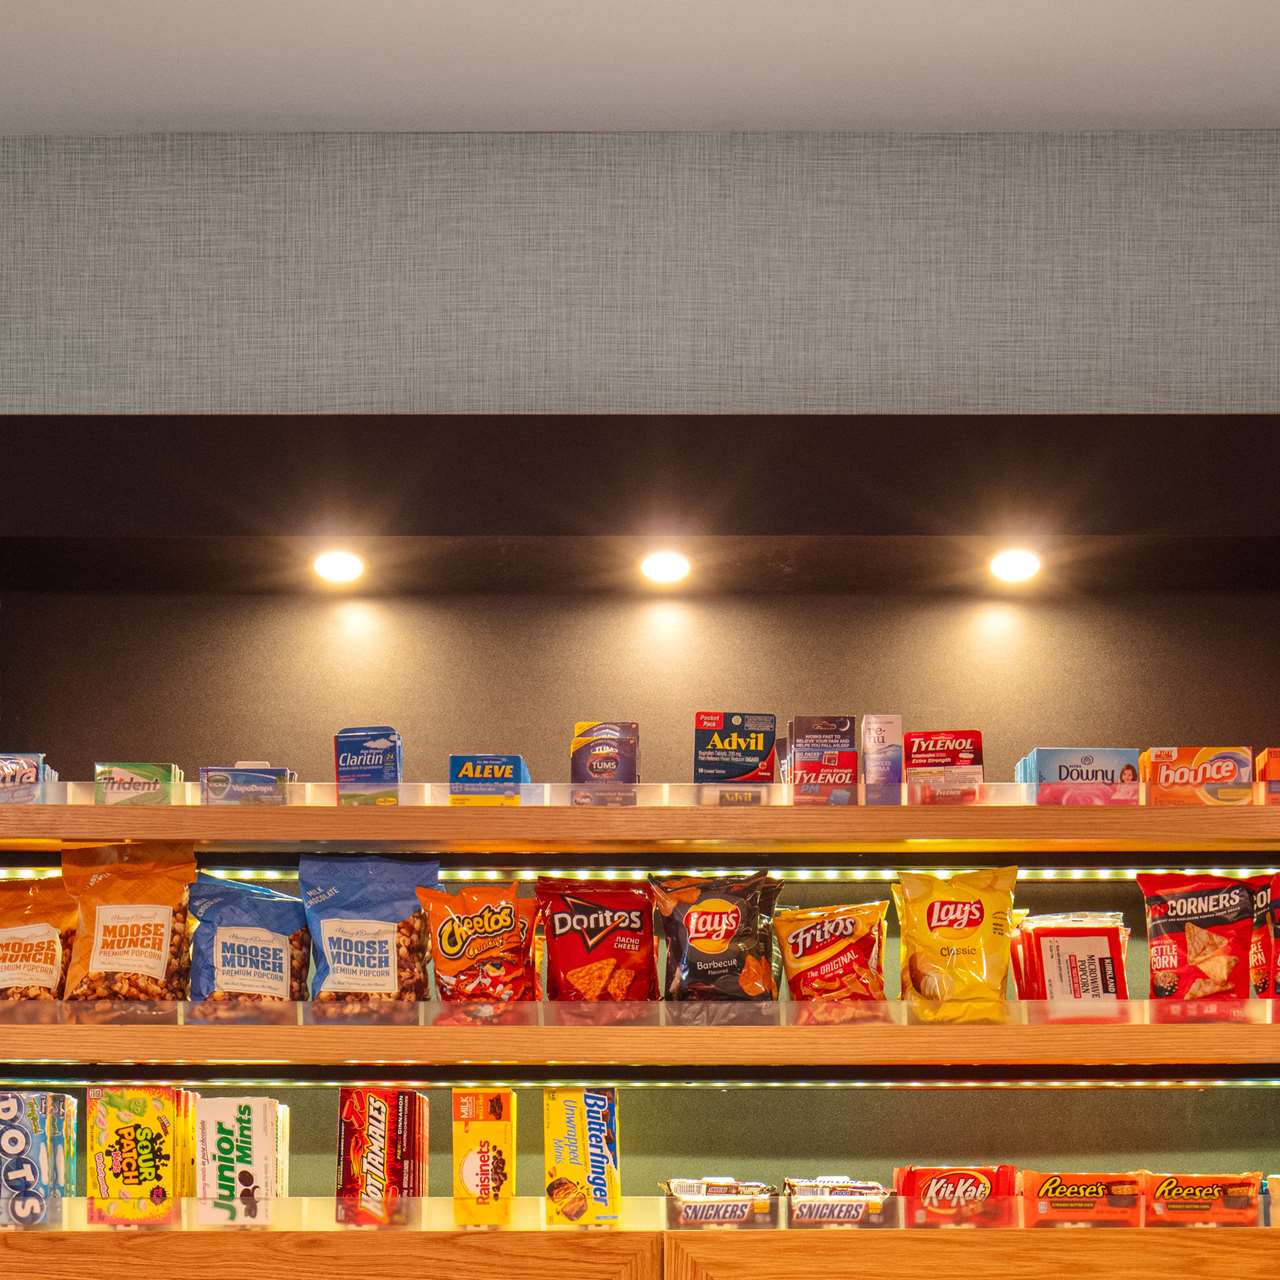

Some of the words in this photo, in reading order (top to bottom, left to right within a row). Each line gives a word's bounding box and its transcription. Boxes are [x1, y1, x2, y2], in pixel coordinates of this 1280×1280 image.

[706, 732, 764, 751] Advil
[910, 737, 974, 753] TYLENOL
[338, 752, 384, 767] Claritin
[457, 761, 514, 779] ALEVE
[591, 761, 618, 770] TUMS
[794, 770, 853, 784] TYLENOL
[1058, 764, 1116, 786] Downy
[1158, 758, 1236, 788] bounce
[104, 776, 160, 792] Trident
[724, 792, 752, 801] Advil
[553, 910, 642, 936] Doritos
[688, 906, 738, 940] Lay's
[930, 901, 982, 929] Lay's
[102, 923, 165, 938] MOOSE
[439, 905, 514, 957] Cheetos
[616, 936, 640, 945] NACHO
[788, 915, 856, 958] Fritos
[101, 936, 163, 951] MUNCH
[221, 941, 283, 962] MOOSE
[328, 936, 389, 955] MOOSE
[614, 943, 640, 951] CHEESE
[940, 946, 977, 957] Classic
[99, 950, 129, 958] PREMIUM
[130, 950, 162, 961] POPCORN
[222, 953, 283, 974] MUNCH
[331, 951, 389, 969] MUNCH
[696, 957, 737, 970] Barbecue
[807, 970, 819, 979] The
[820, 950, 859, 975] ORIGINAL
[1151, 956, 1178, 970] CORN
[22, 965, 53, 976] POPCORN
[222, 969, 253, 978] PREMIUM
[253, 970, 283, 982] POPCORN
[359, 968, 390, 978] POPCORN
[1078, 959, 1090, 994] POPCORN
[1087, 954, 1101, 999] MICROWAVE
[1104, 958, 1116, 994] KIRKLAND
[461, 1096, 469, 1118] MILK
[236, 1104, 252, 1166] Mints
[361, 1094, 386, 1177] TAMALES
[563, 1099, 582, 1166] Unwrapped
[119, 1125, 139, 1185] PATCH
[136, 1127, 156, 1182] SOUR
[553, 1138, 564, 1164] Minis
[584, 1093, 608, 1206] Butterfinger
[214, 1121, 237, 1221] Junior
[475, 1140, 490, 1205] Raisinets
[360, 1173, 385, 1217] HOT
[1039, 1176, 1106, 1199] Reese's
[1155, 1178, 1222, 1201] Reese's
[683, 1203, 748, 1220] SNICKERS
[795, 1203, 863, 1220] SNICKERS
